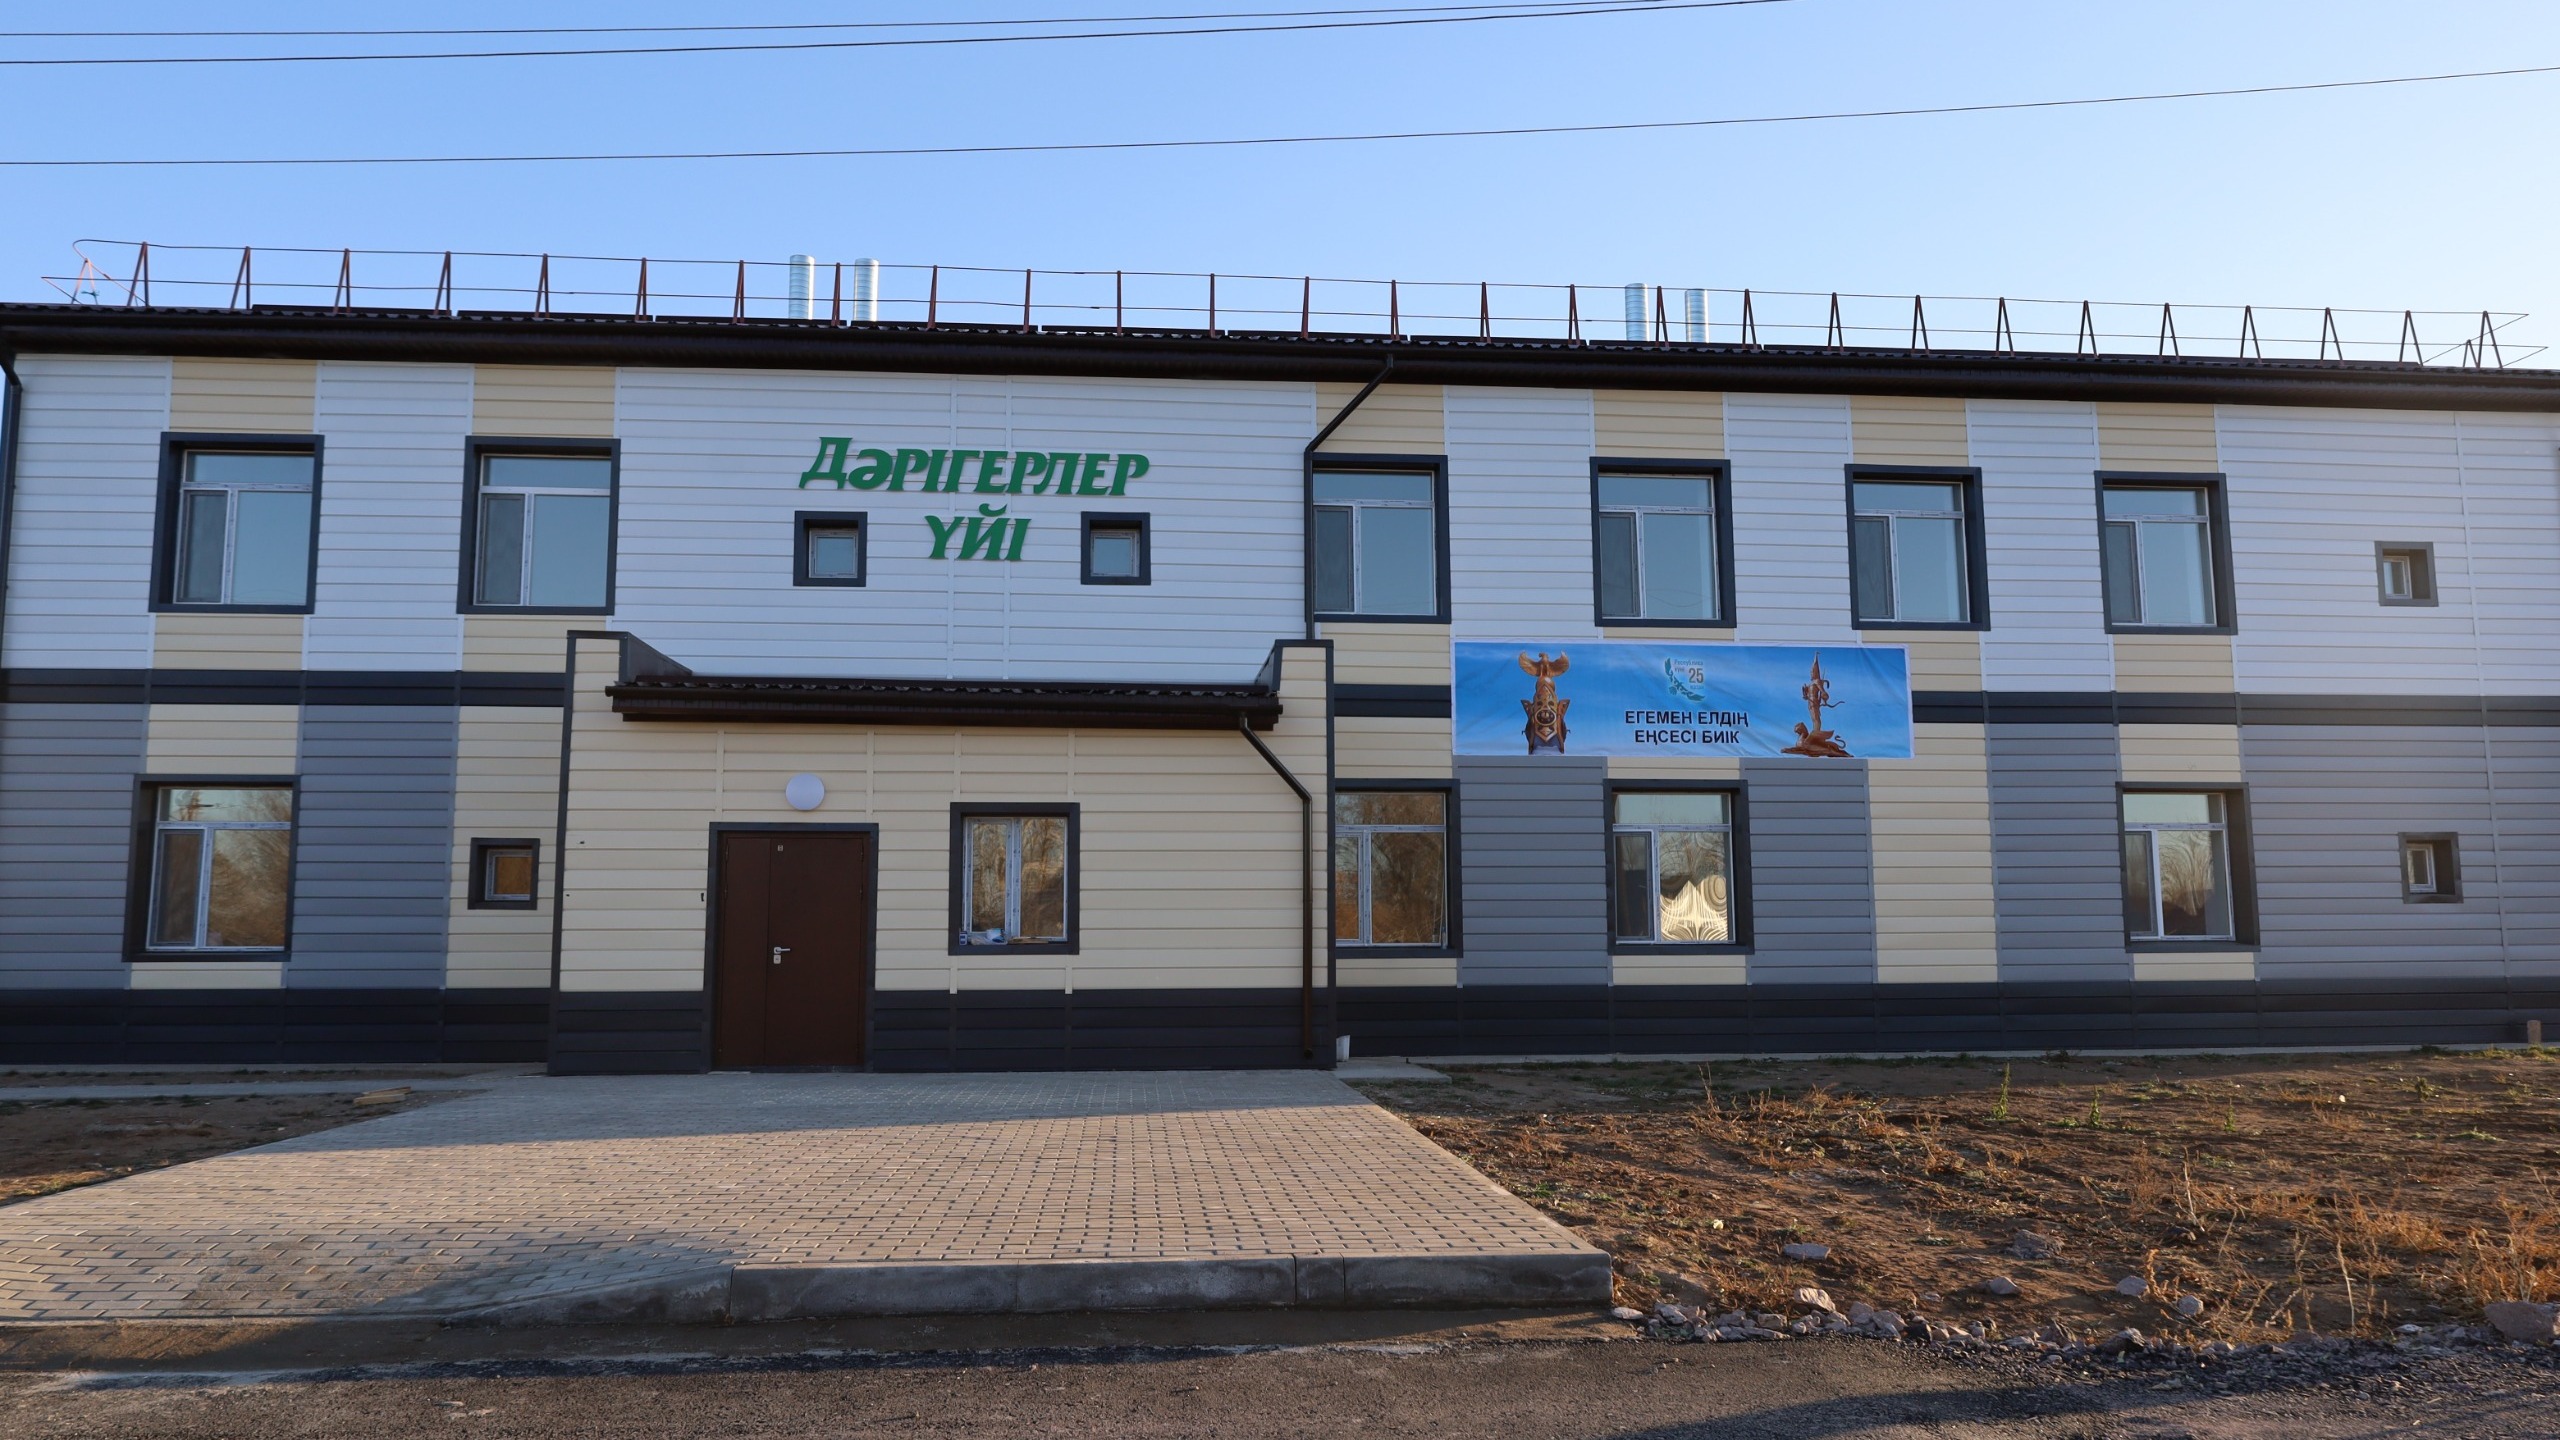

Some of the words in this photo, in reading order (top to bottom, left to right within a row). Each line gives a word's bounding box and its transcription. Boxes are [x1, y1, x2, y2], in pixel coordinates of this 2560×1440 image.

[799, 436, 1150, 496] ДӘРІГЕРЛЕР
[924, 503, 1032, 561] ҮЙІ
[1688, 667, 1704, 684] 25
[1625, 710, 1692, 724] ЕГЕМЕН
[1698, 711, 1749, 727] ЕЛДІҢ
[1635, 730, 1697, 745] ЕҢСЕСІ
[1702, 731, 1740, 743] БИІК
